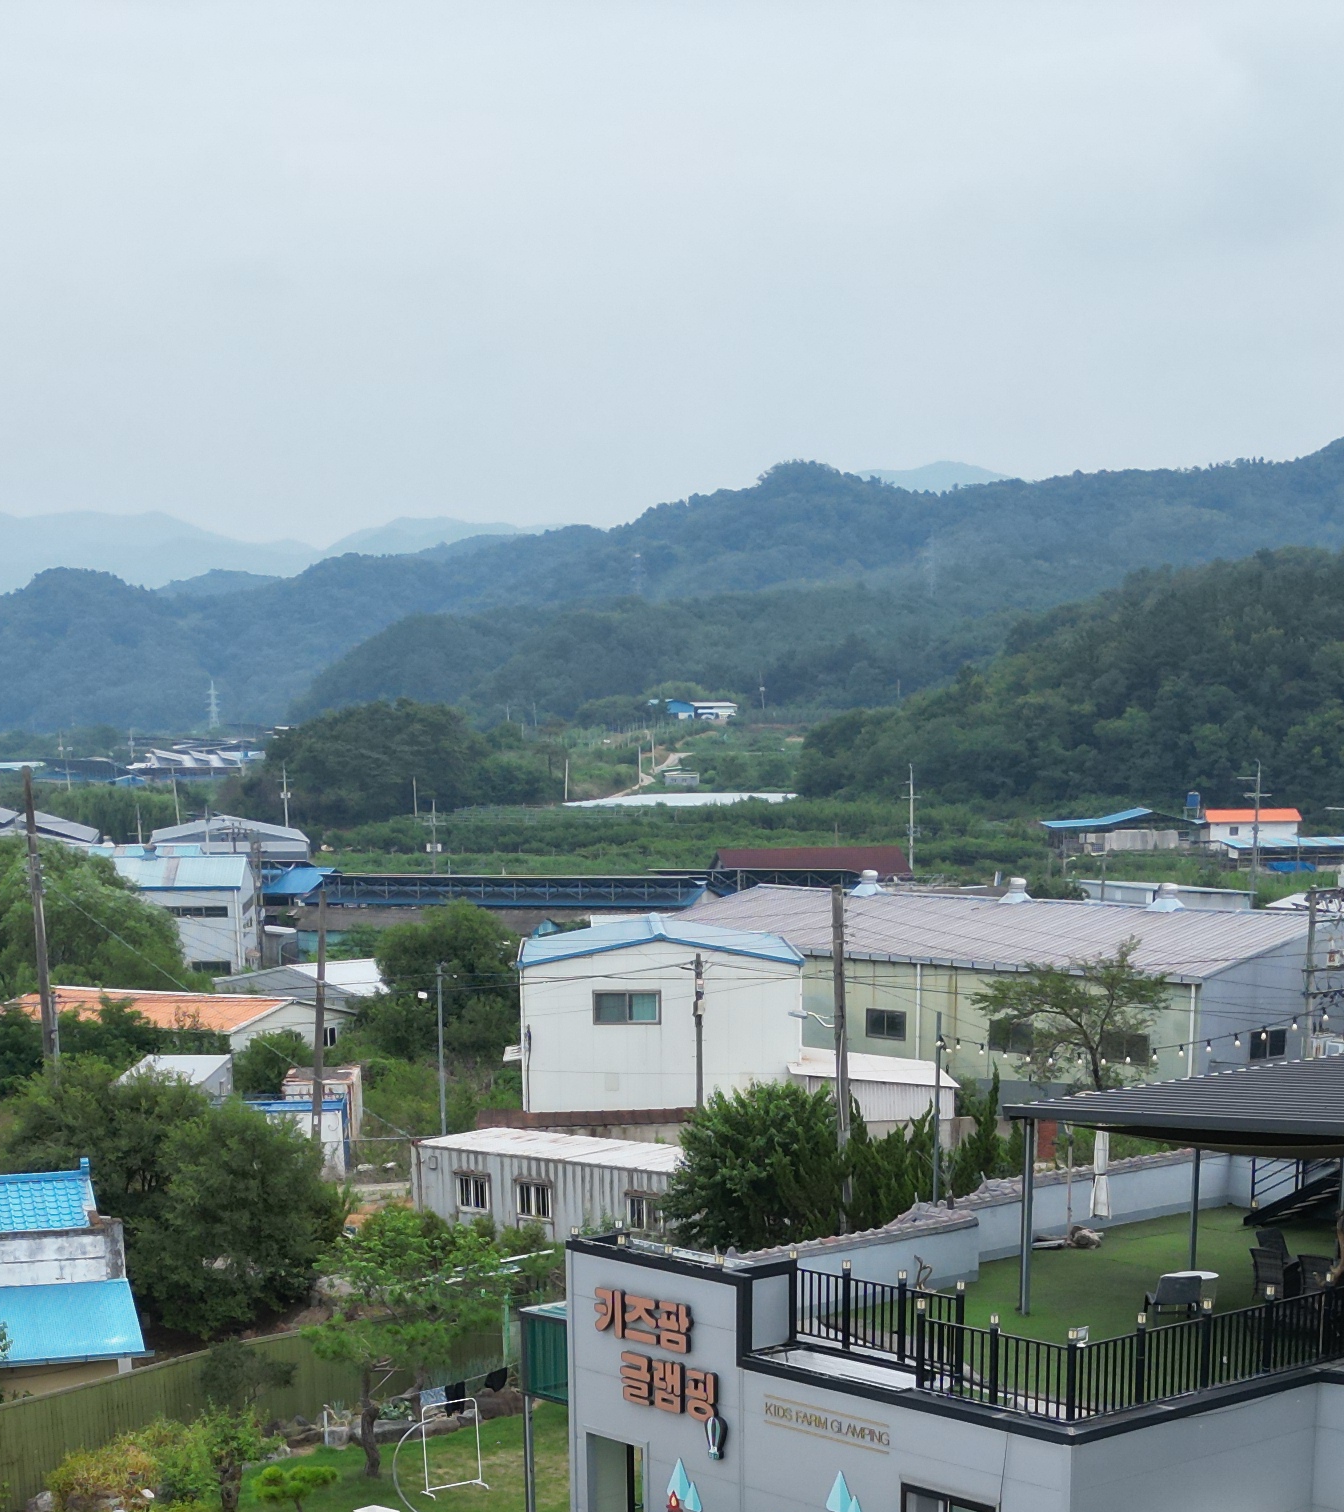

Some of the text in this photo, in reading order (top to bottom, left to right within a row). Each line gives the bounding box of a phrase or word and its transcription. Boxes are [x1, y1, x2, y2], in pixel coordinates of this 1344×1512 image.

[594, 1286, 693, 1354] 키즈팜
[620, 1350, 719, 1422] 글램핑
[764, 1401, 890, 1446] KIDS FARM GLAMPING
